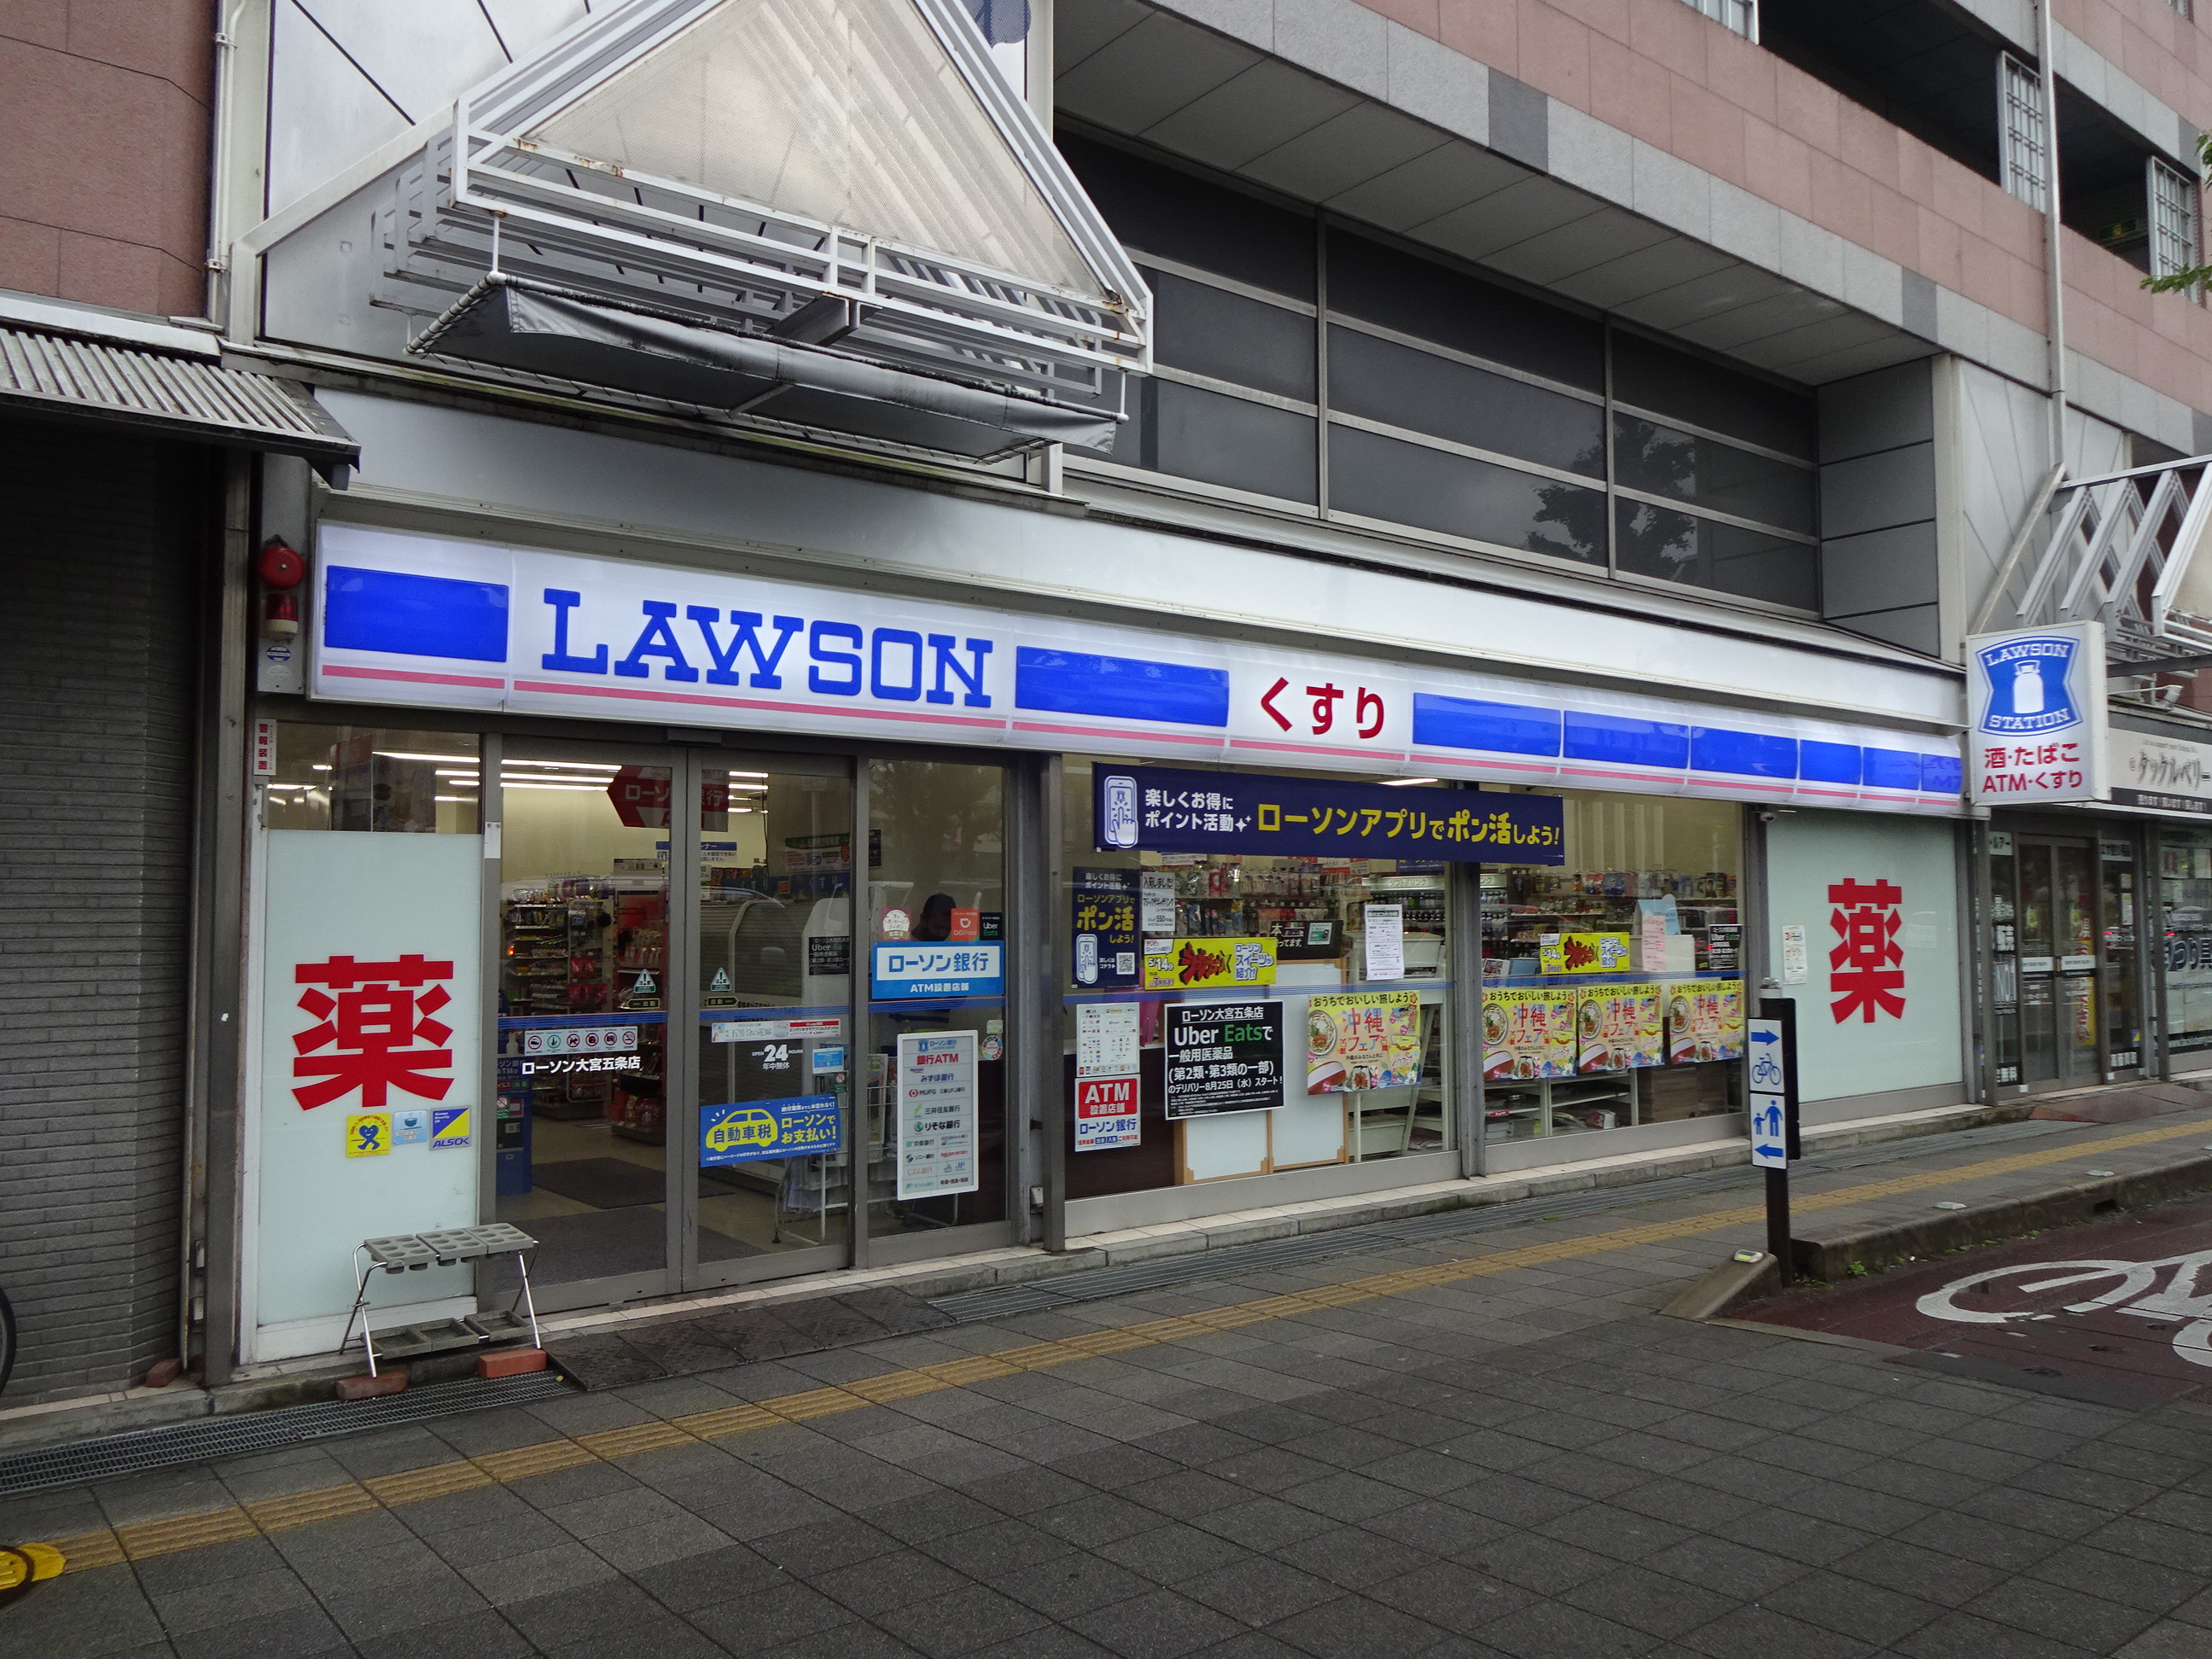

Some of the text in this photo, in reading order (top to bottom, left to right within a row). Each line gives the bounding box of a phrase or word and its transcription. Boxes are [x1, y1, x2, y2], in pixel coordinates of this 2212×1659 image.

[541, 587, 993, 708] LAWSON
[1984, 643, 2070, 667] LAWSON
[1260, 677, 1385, 740] くすり
[1989, 707, 2071, 730] STATION
[1984, 742, 2080, 770] 酒・たばこ
[1982, 769, 2084, 794] ATM・くすり
[1145, 789, 1234, 811] 楽しくお得に
[1145, 810, 1234, 833] ポイント活動
[1077, 894, 1136, 904] ローソンアプリで
[1076, 905, 1135, 931] ポン活
[1236, 944, 1260, 952] ローソン
[1828, 877, 1906, 1024] 薬
[888, 952, 989, 973] ローソン銀行
[910, 982, 969, 993] ATM設置店舗
[1313, 992, 1409, 1007] おうちでおいしい旅しよう
[1182, 1006, 1264, 1022] ローソン大宮五条店
[1513, 1003, 1547, 1028] 沖縄
[1606, 998, 1636, 1022] 沖縄
[1342, 1007, 1385, 1035] 沖縄
[291, 954, 455, 1111] 薬
[1173, 1026, 1219, 1046] Uber
[1516, 1028, 1544, 1043] フェア
[1348, 1034, 1381, 1051] フェア
[764, 1044, 789, 1062] 24
[917, 1052, 959, 1066] 銀行ATM
[1168, 1046, 1233, 1063] 一般用医薬品
[521, 1056, 641, 1075] ローソン大宮五条店
[762, 1061, 790, 1071] 年中無休
[1085, 1082, 1130, 1104] ATM
[1090, 1102, 1126, 1115] 設置店舗
[781, 1115, 836, 1129] ローソンで
[924, 1120, 961, 1132] りそな銀行
[1080, 1118, 1137, 1135] ローソン銀行
[432, 1137, 470, 1149] ALSOK
[713, 1123, 772, 1144] 自動車税
[781, 1126, 837, 1144] お支払い!
